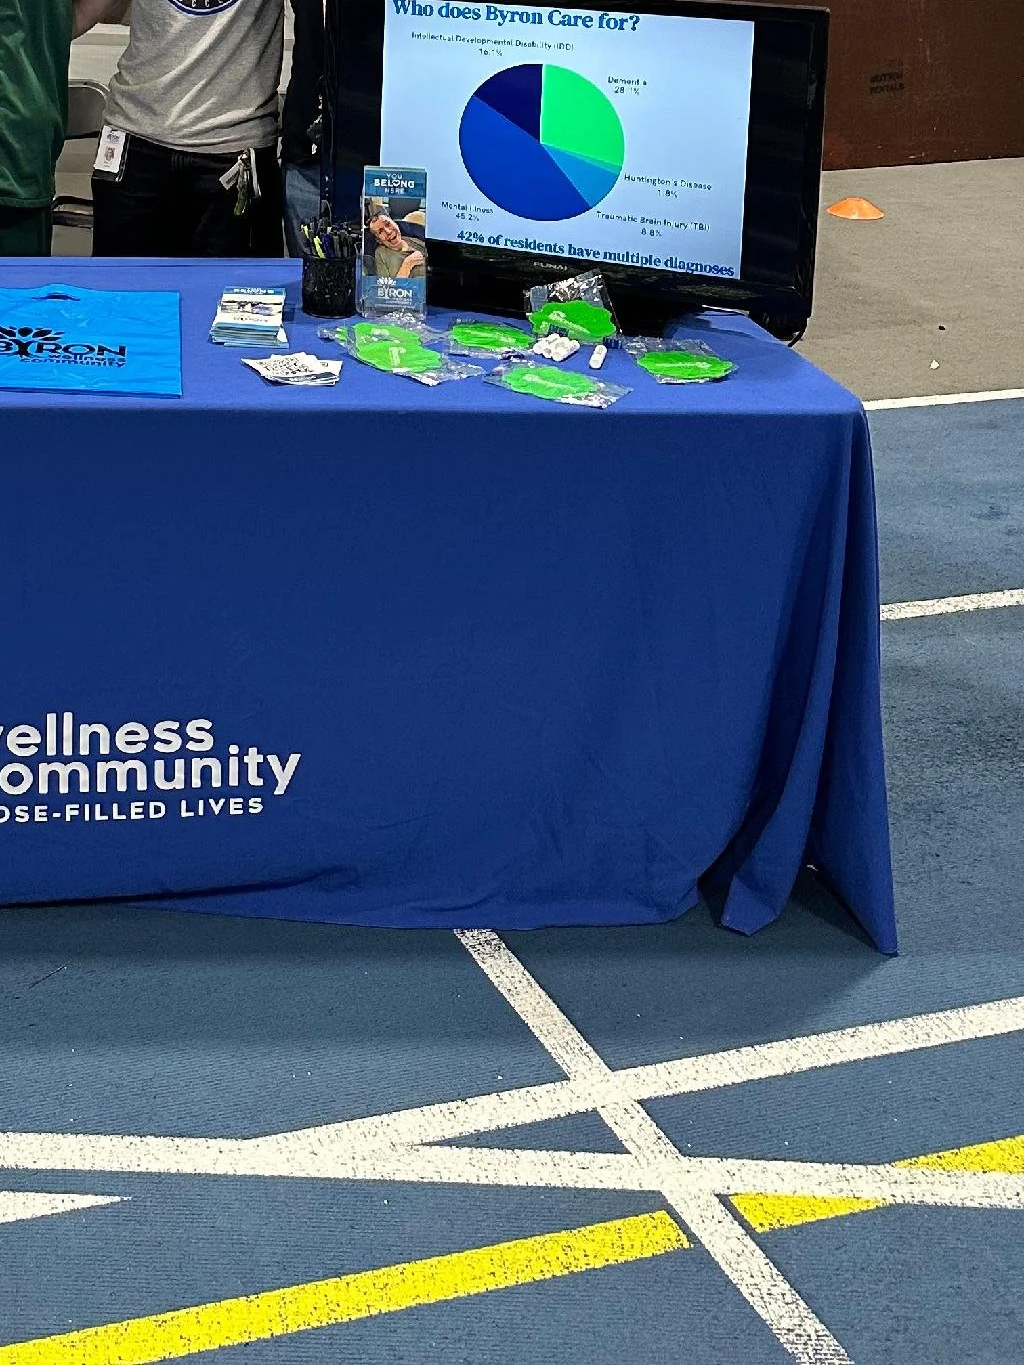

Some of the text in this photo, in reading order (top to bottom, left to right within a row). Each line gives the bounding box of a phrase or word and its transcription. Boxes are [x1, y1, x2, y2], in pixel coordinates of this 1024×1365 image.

[392, 0, 641, 32] Who does Byron Care for?
[374, 178, 415, 189] BELONG
[457, 230, 736, 277] 42% of residents have multiple diagnoses
[377, 286, 413, 299] BYRON
[179, 797, 265, 819] LIVES
